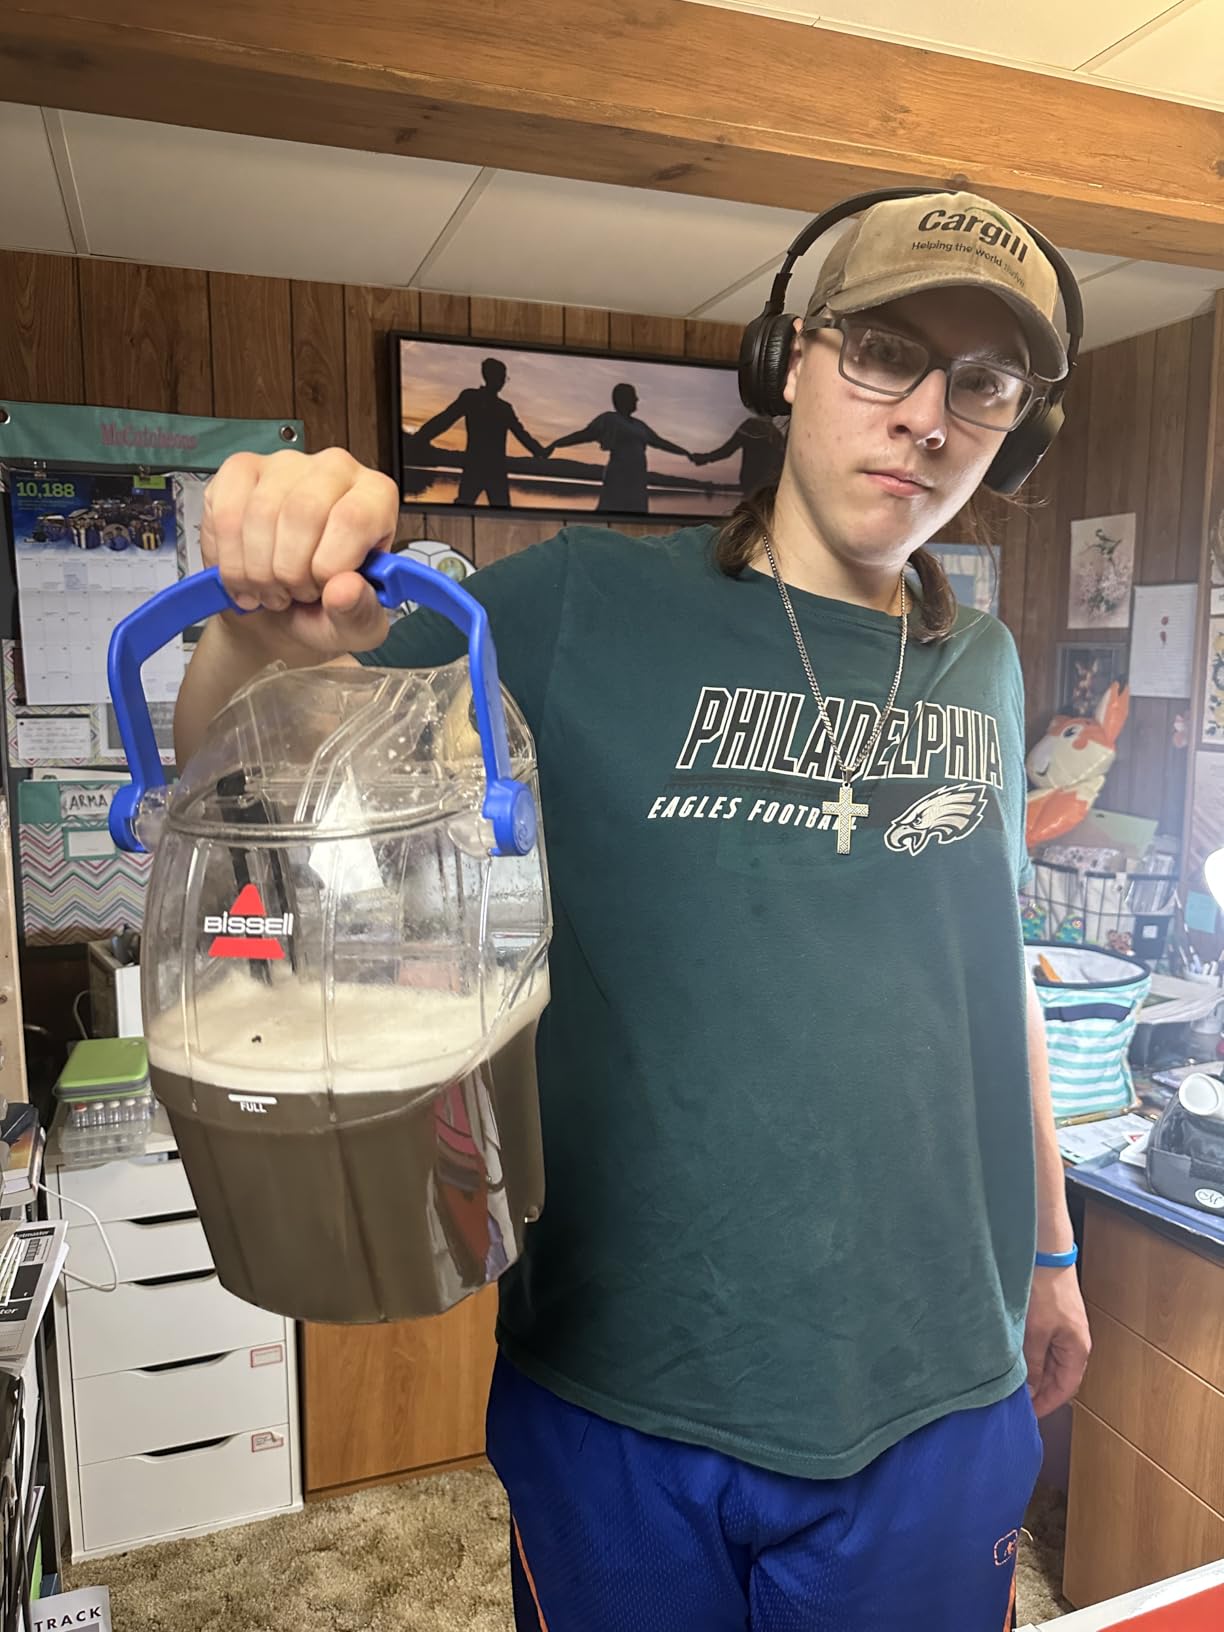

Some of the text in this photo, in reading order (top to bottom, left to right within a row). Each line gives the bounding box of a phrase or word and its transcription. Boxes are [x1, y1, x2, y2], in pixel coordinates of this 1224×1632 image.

[912, 240, 953, 252] Helping
[955, 243, 973, 253] the
[918, 209, 1028, 263] Cargill
[16, 482, 75, 498] 10,188
[675, 686, 1003, 789] PHILADELPHIA
[648, 796, 742, 820] EAGLES
[240, 1101, 267, 1113] FULL
[34, 1606, 102, 1632] TRACK
